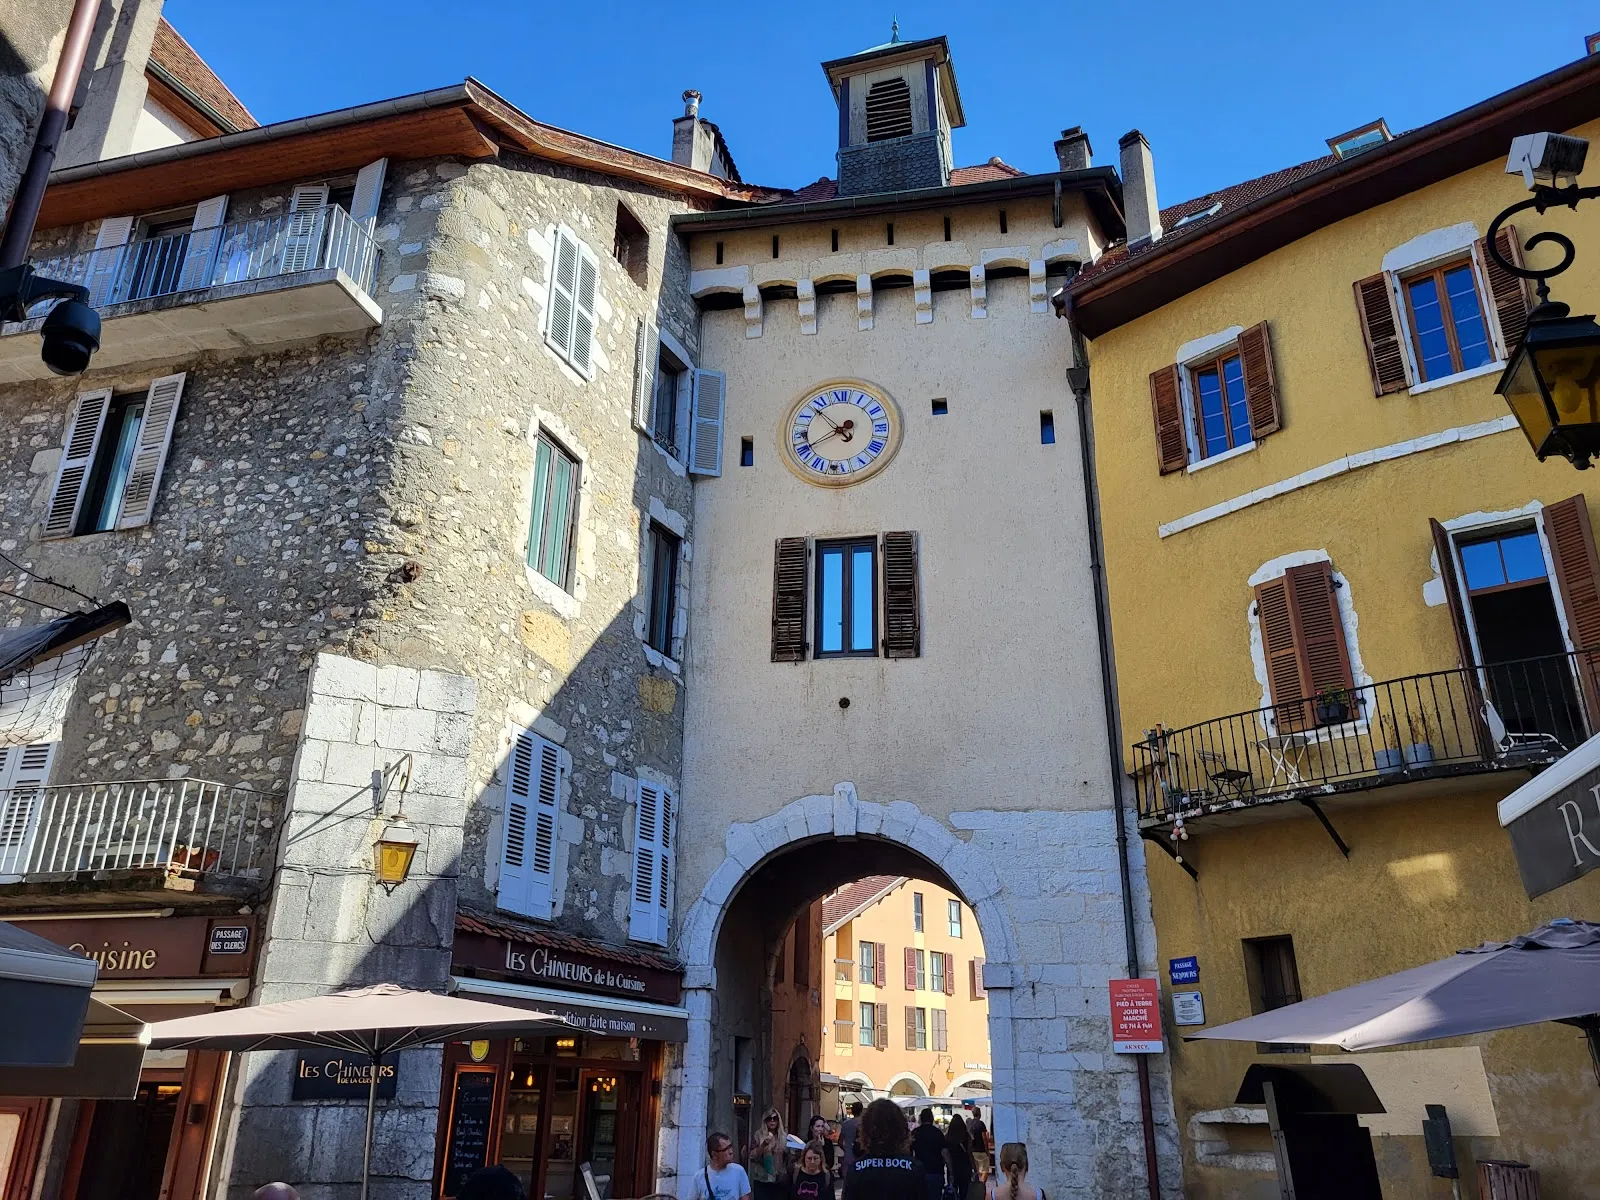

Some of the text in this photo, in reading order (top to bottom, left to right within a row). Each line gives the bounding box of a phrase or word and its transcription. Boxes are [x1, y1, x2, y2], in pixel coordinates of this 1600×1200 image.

[215, 930, 243, 939] PASSAGE
[211, 941, 245, 950] DES CLERCS
[1174, 961, 1192, 969] PASSAGE
[594, 969, 606, 985] de
[606, 970, 615, 987] la
[616, 973, 646, 992] Cuisine
[589, 1013, 607, 1029] faite
[609, 1017, 636, 1032] maison
[855, 1157, 912, 1171] SUPER BOCK
